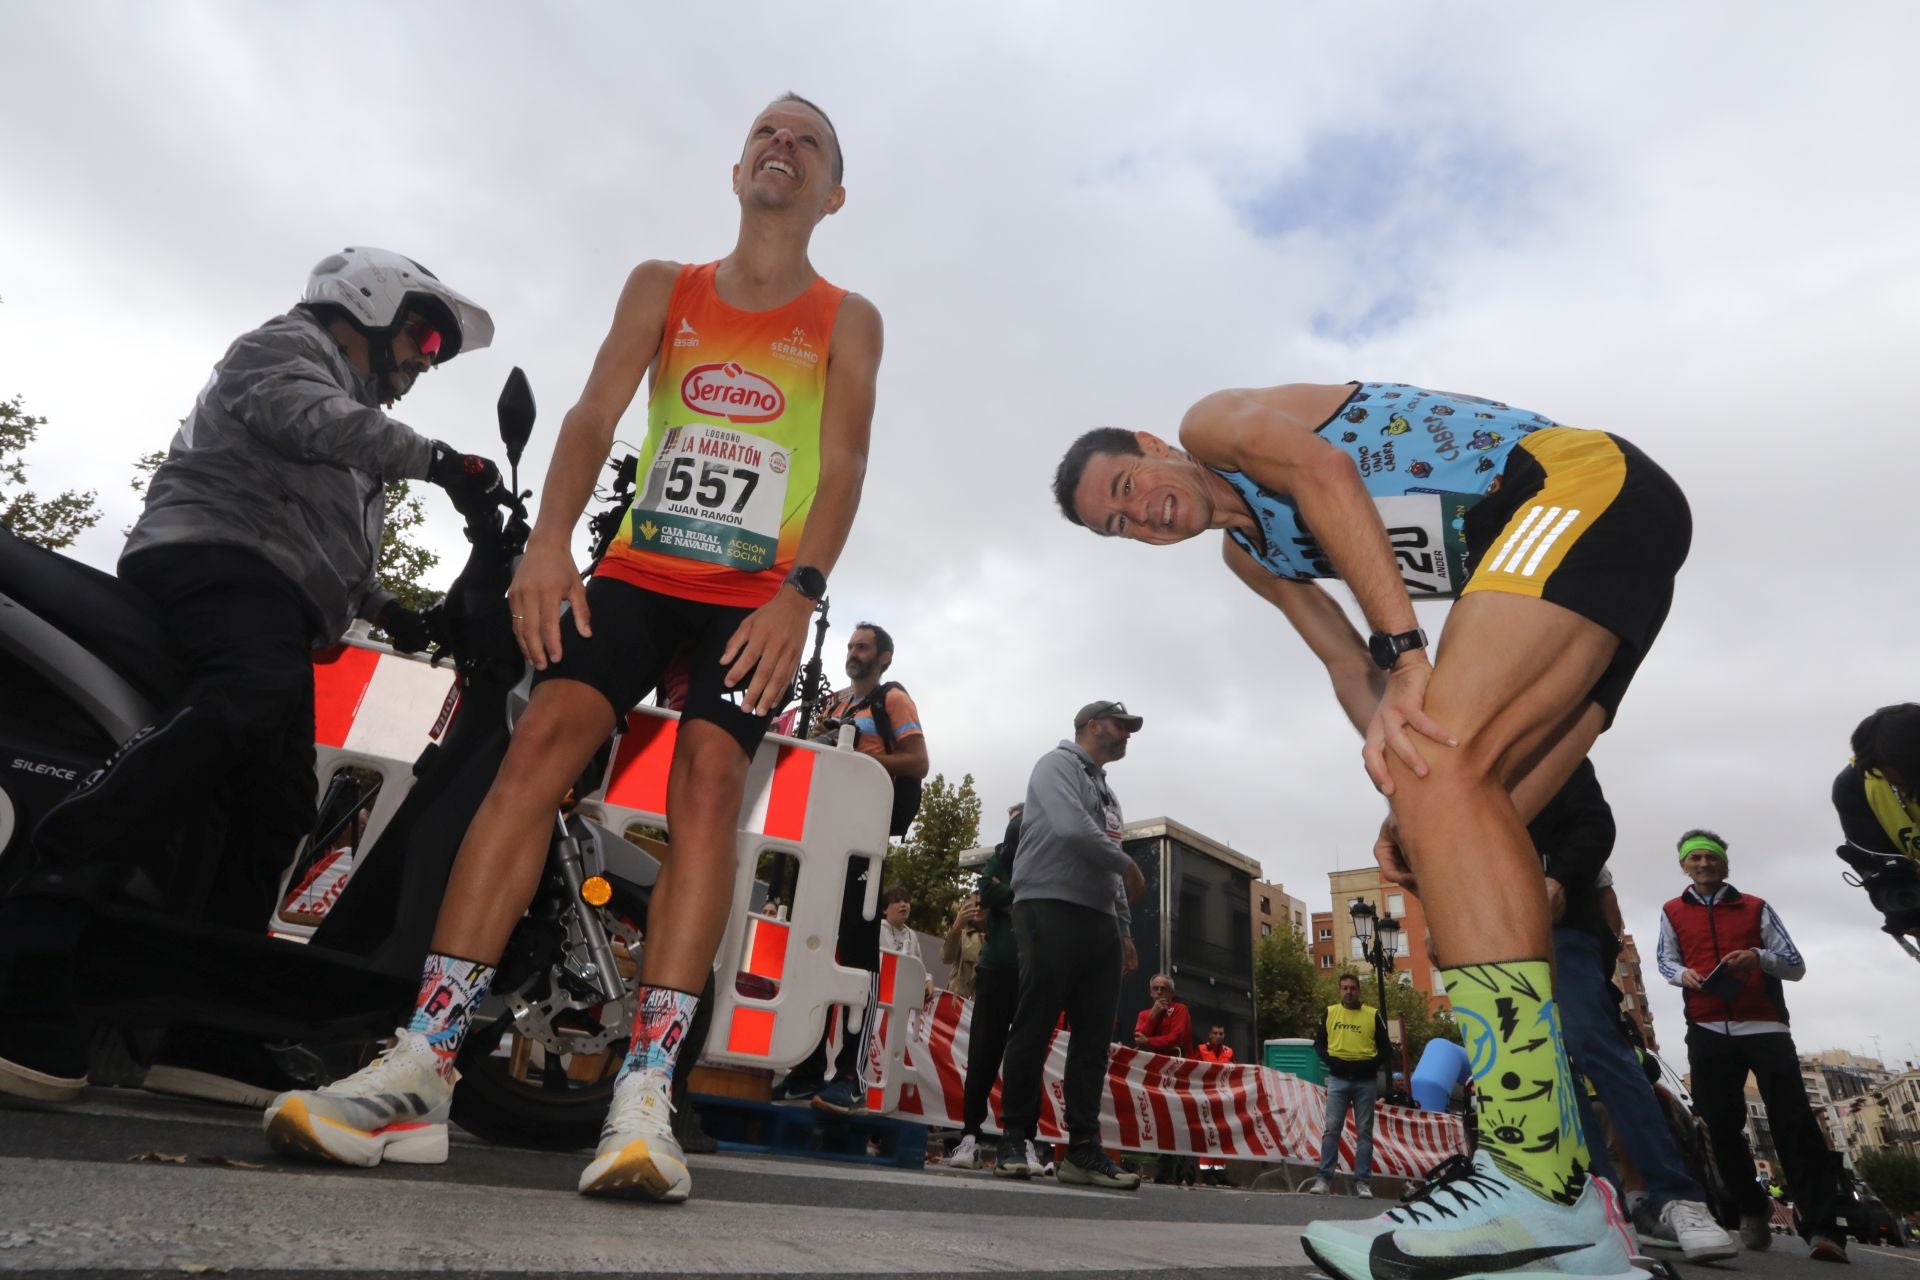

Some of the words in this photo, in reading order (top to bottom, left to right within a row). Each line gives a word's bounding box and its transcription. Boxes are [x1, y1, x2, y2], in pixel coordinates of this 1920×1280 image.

[771, 342, 818, 363] SERRANO
[689, 375, 777, 411] Serrano
[705, 428, 741, 443] LOGROÑO
[681, 436, 694, 453] LA
[698, 438, 762, 467] MARATÓN
[1358, 445, 1371, 478] COMO
[1371, 451, 1383, 473] UNA
[1383, 440, 1396, 472] CABRA
[665, 457, 760, 513] 557
[668, 503, 698, 516] JUAN
[701, 509, 743, 525] RAMÓN
[660, 534, 672, 545] DE
[674, 537, 723, 554] NAVARRA
[661, 526, 684, 538] CAJA
[685, 530, 720, 545] RURAL
[728, 538, 766, 555] ACCIÓN
[727, 548, 764, 565] SOCIAL
[1434, 550, 1447, 578] ANDER
[11, 758, 77, 781] SILENCE
